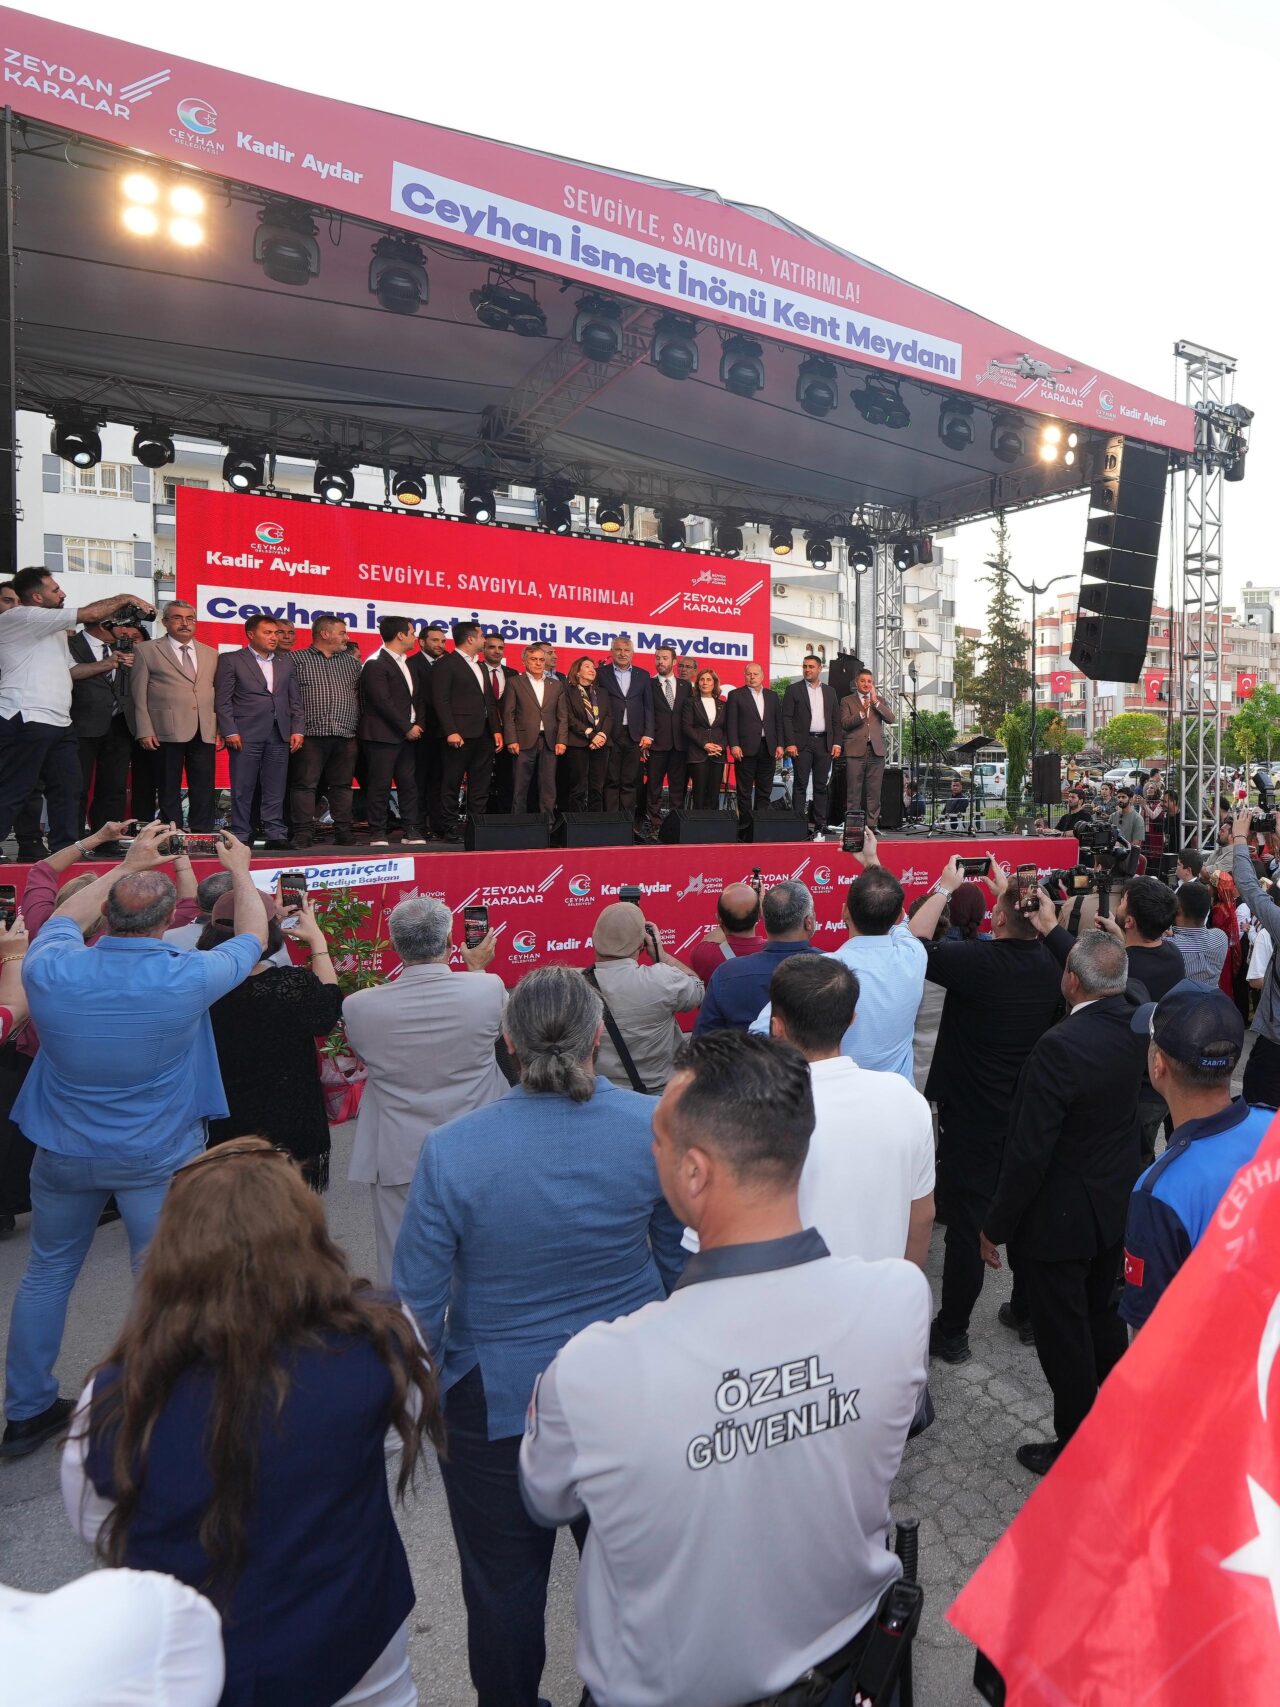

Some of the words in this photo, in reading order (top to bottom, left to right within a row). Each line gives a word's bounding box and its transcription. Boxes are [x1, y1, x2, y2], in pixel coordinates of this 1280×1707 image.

[4, 47, 113, 97] ZEYDAN
[4, 67, 130, 120] KARALAR
[169, 128, 224, 151] CEYHAN
[236, 131, 295, 164] Kadir
[301, 153, 363, 184] Aydar
[563, 184, 665, 243] SEVGİYLE,
[672, 222, 763, 275] SAYGIYLA,
[770, 254, 860, 304] YATIRIMLA!
[401, 182, 562, 256] Ceyhan
[570, 224, 671, 290] İsmet
[679, 259, 766, 319] İnönü
[773, 298, 840, 341] Kent
[846, 320, 956, 375] Meydanı
[1040, 390, 1084, 409] KARALAR
[1120, 405, 1142, 419] Kadir
[1144, 412, 1167, 427] Aydar
[250, 543, 291, 552] CEYHAN
[206, 551, 263, 569] Kadir
[270, 557, 330, 577] Aydar
[358, 563, 452, 590] SEVGİYLE,
[457, 573, 543, 599] SAYGIYLA,
[549, 583, 634, 607] YATIRIMLA!
[683, 592, 733, 605] ZEYDAN
[683, 602, 741, 616] KARALAR
[482, 885, 535, 896] ZEYDAN
[482, 894, 544, 906] KARALAR
[565, 896, 595, 904] CEYHAN
[547, 938, 579, 951] Kadir
[508, 952, 541, 961] CEYHAN
[715, 1355, 833, 1415] ÖZEL
[686, 1388, 860, 1471] GÜVENLİK
